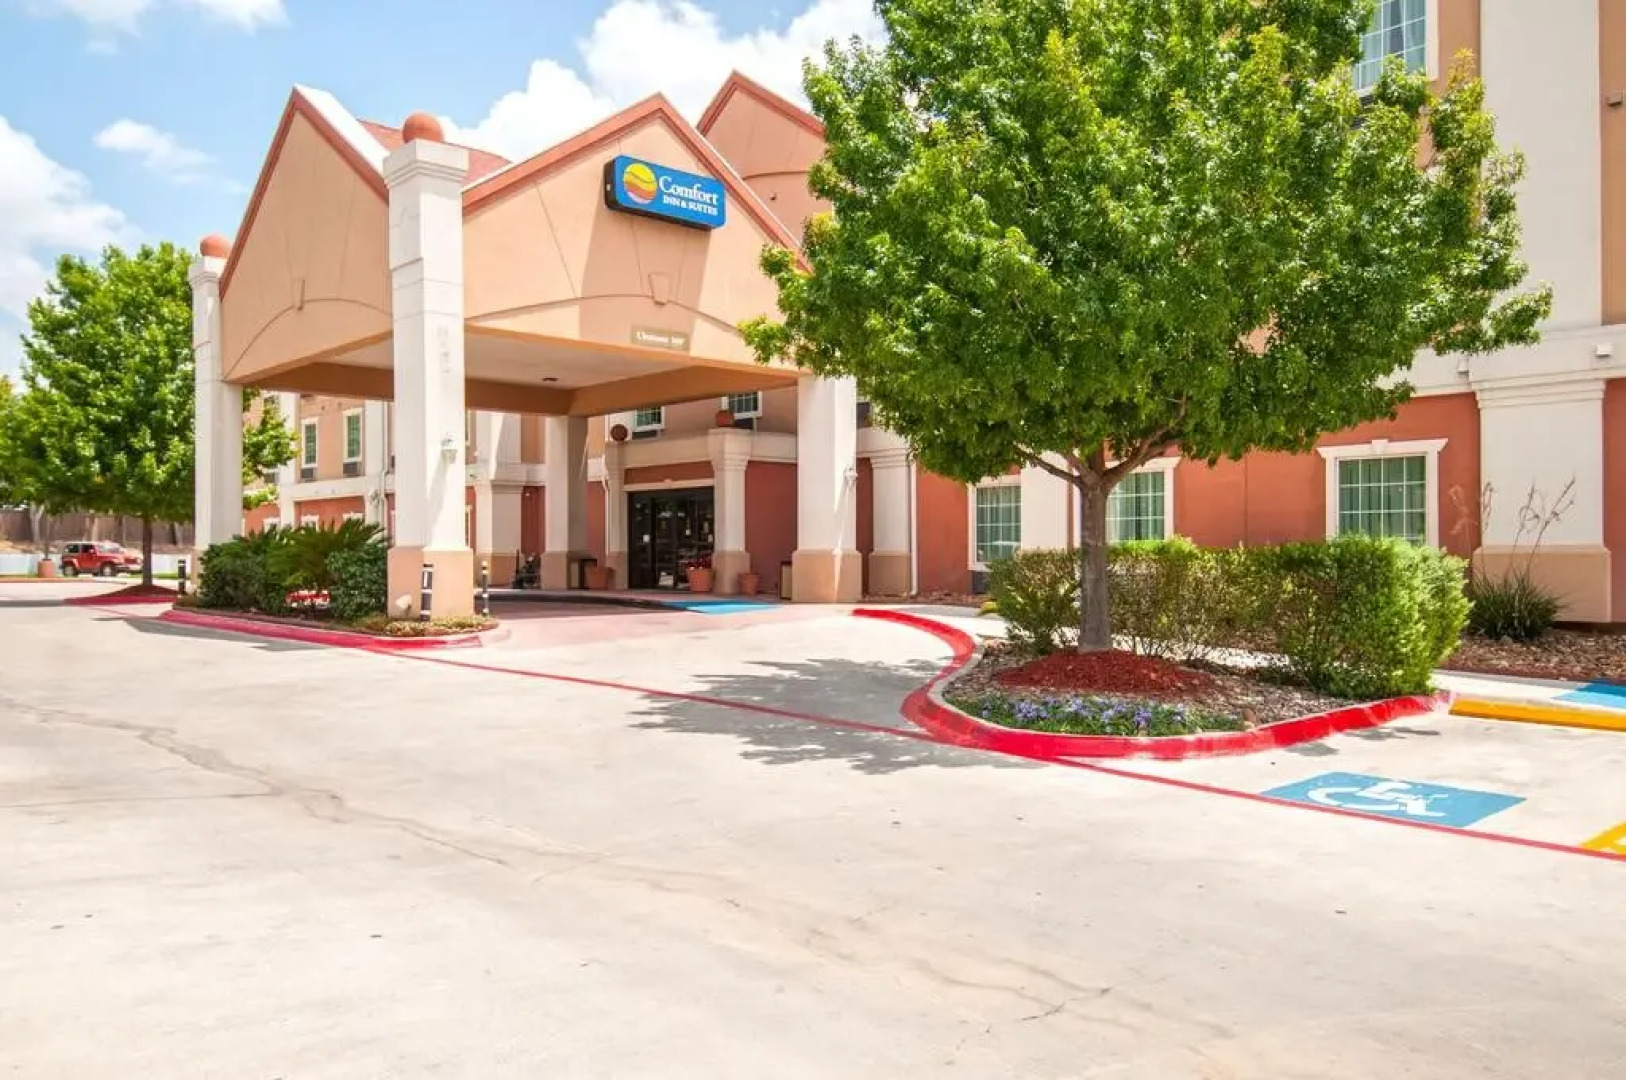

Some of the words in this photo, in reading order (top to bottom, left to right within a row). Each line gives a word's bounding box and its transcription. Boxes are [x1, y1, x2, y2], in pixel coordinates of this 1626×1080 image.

[659, 175, 718, 206] Comfort
[663, 194, 680, 207] INN
[688, 201, 718, 216] SUITES
